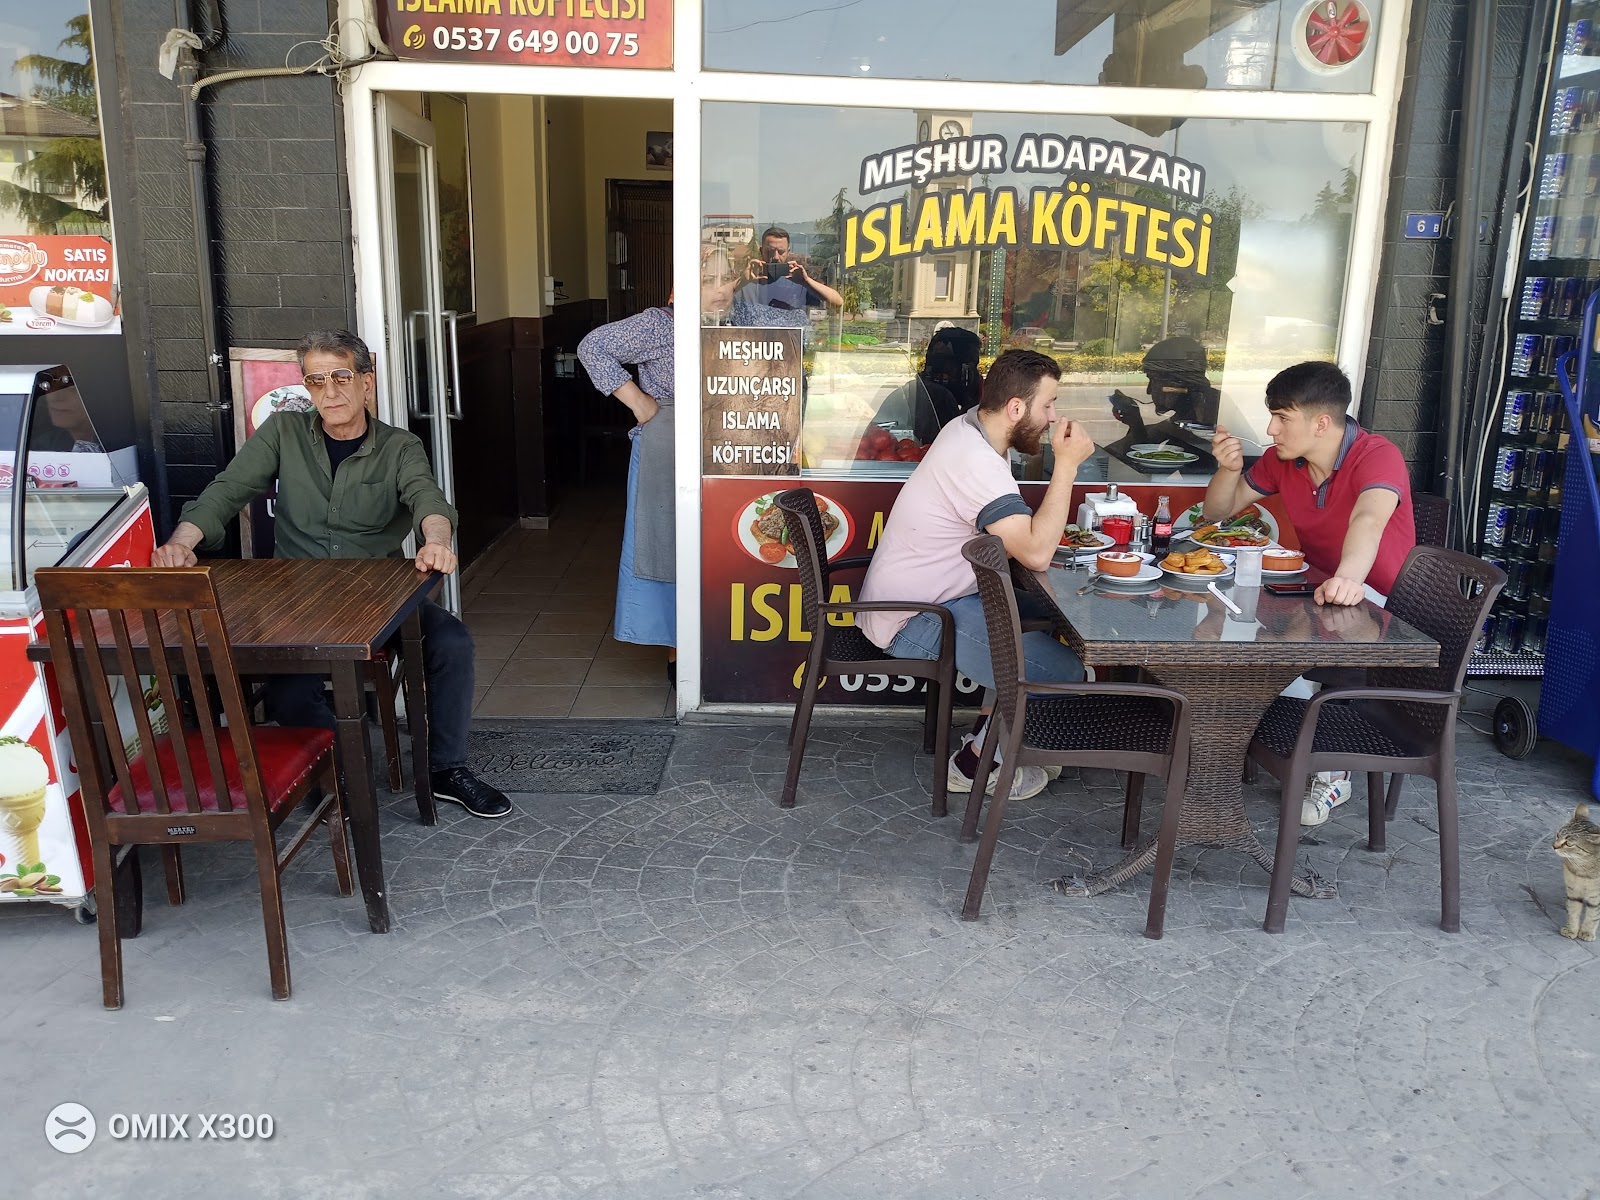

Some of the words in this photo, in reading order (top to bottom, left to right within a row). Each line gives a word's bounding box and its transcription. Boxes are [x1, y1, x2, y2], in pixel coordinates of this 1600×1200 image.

[433, 26, 501, 51] 0537
[508, 29, 559, 53] 649
[565, 31, 599, 55] 00
[606, 33, 640, 56] 75
[863, 138, 1004, 184] MEŞHUR
[1016, 137, 1202, 199] ADAPAZARI
[845, 191, 1018, 268] ISLAMA
[1031, 180, 1213, 277] KÖFTESİ
[1417, 219, 1426, 233] 6
[1433, 223, 1440, 233] B
[64, 248, 108, 264] SATIŞ
[44, 268, 109, 282] NOKTASI
[719, 340, 784, 366] MEŞHUR
[706, 376, 796, 401] UZUNÇARŞI
[722, 411, 781, 430] ISLAMA
[712, 441, 791, 464] KÖFTECİSİ
